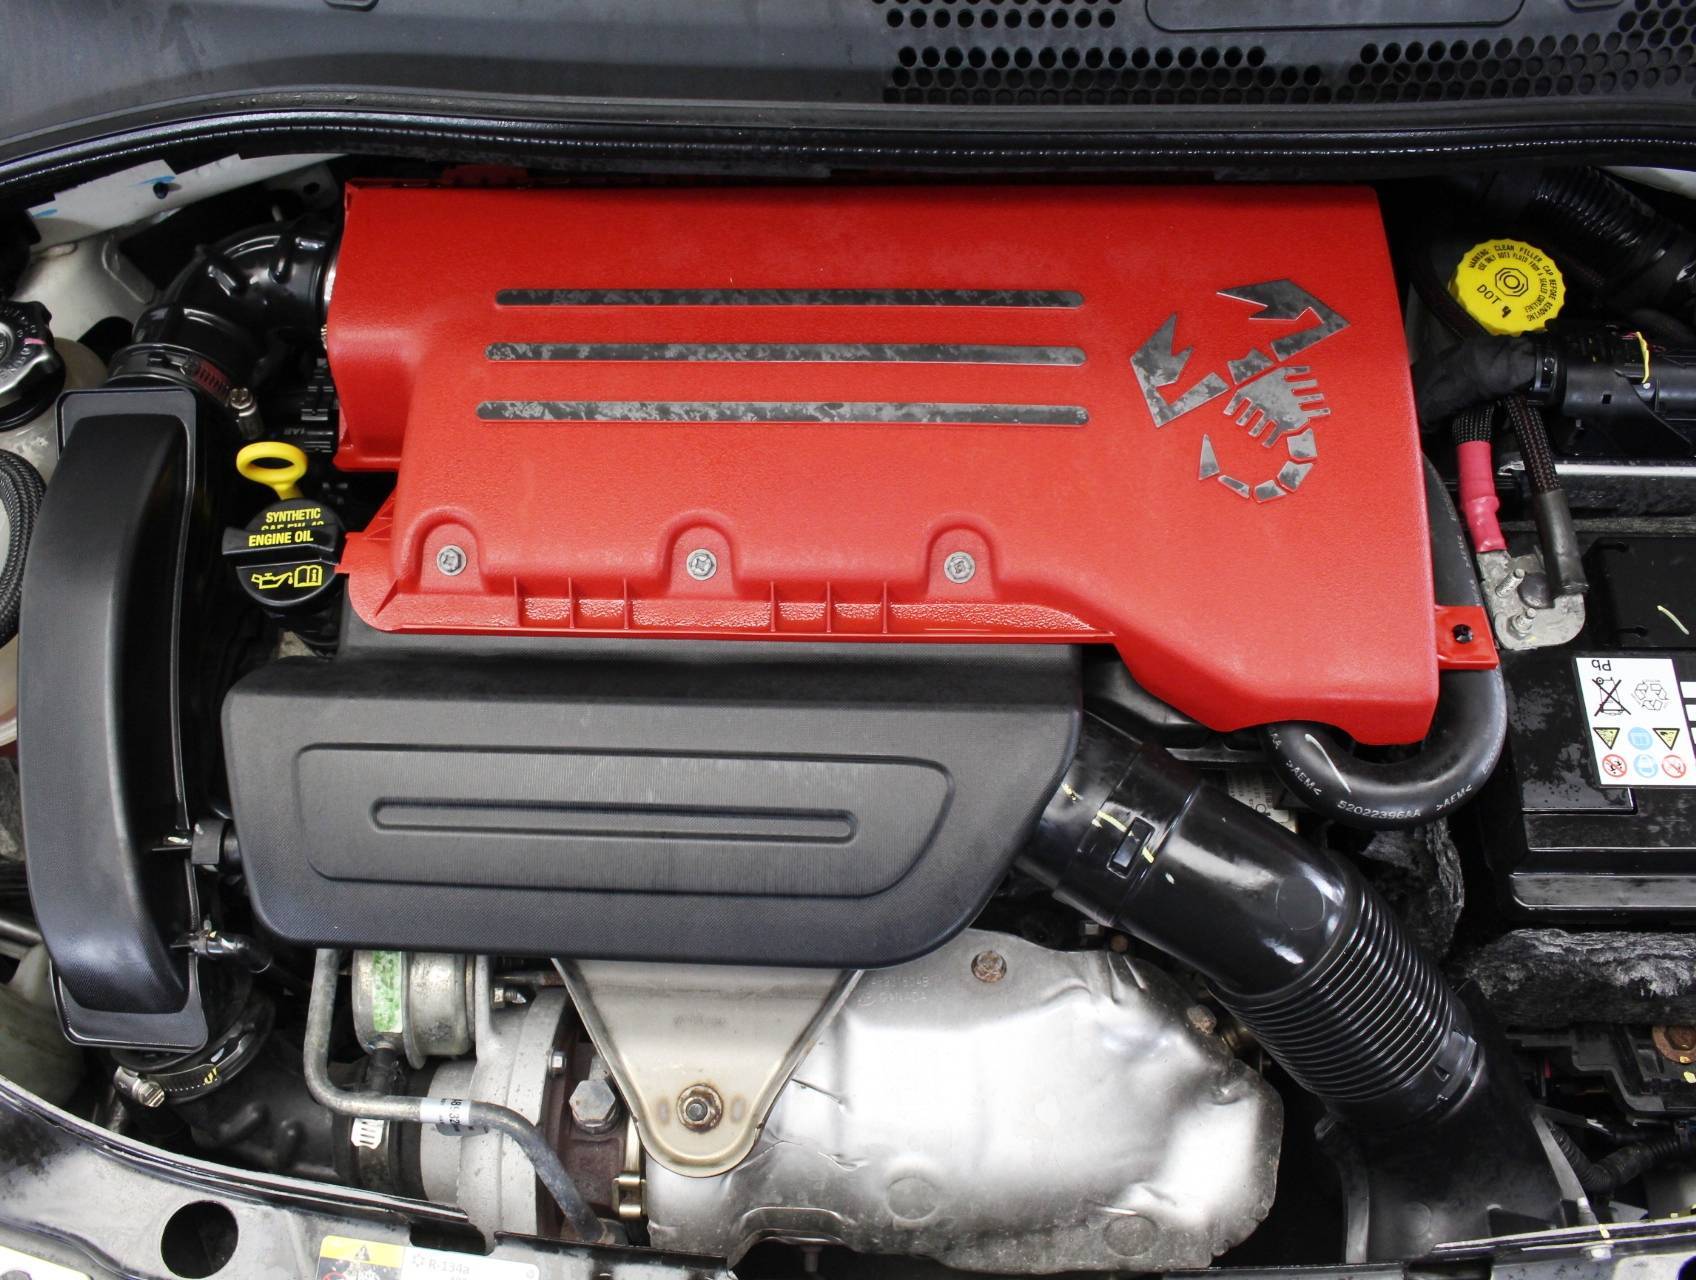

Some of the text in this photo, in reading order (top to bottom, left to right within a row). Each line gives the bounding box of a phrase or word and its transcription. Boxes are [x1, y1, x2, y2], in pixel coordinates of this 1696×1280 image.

[1494, 244, 1515, 252] CLEAN
[1519, 247, 1543, 262] FILLER
[1542, 265, 1554, 276] CAP
[1548, 279, 1557, 301] BEFORE
[1476, 284, 1502, 304] DOT
[266, 508, 321, 524] SYNTHETIC
[248, 530, 314, 547] ENGINE OIL
[1591, 659, 1612, 671] Pb
